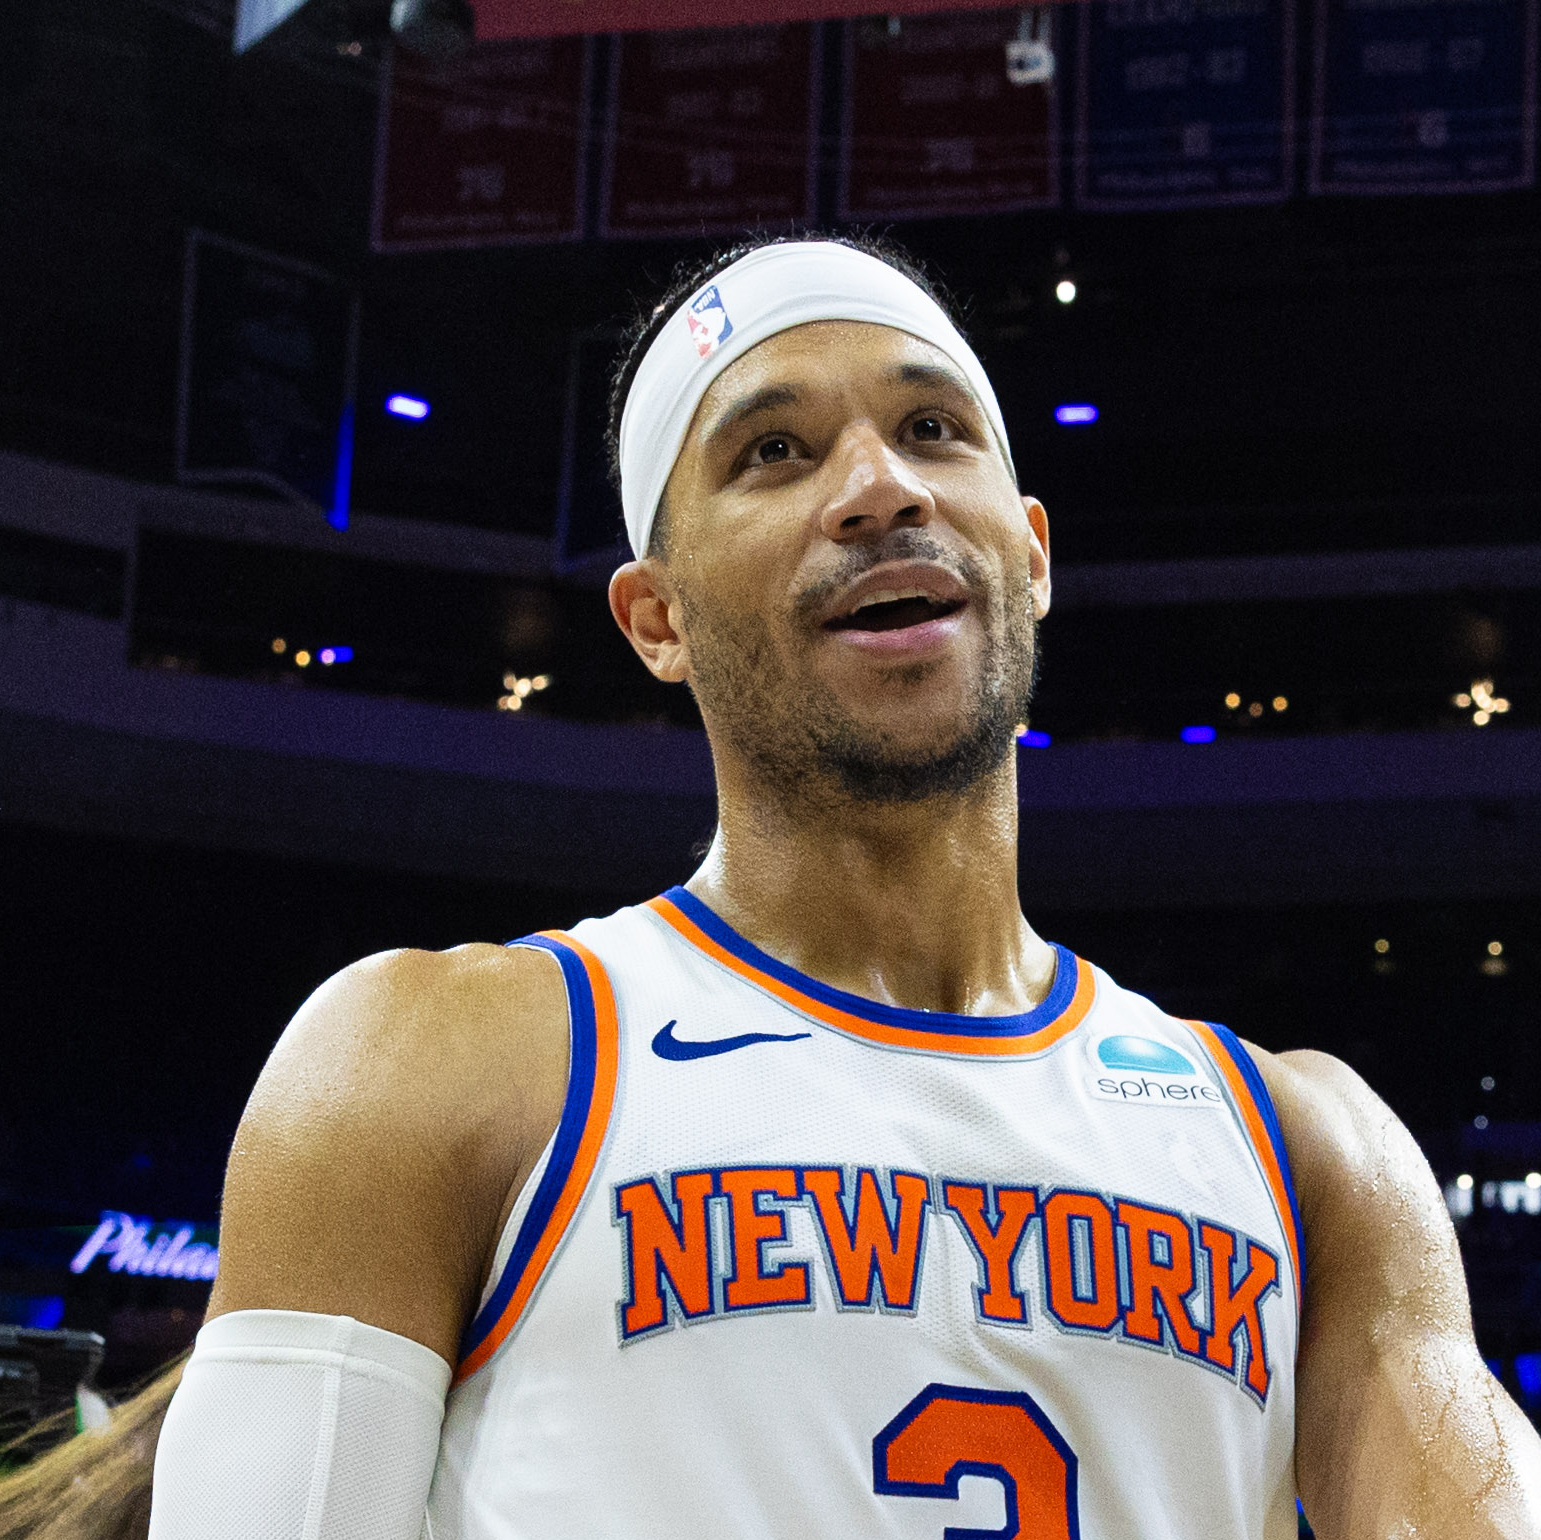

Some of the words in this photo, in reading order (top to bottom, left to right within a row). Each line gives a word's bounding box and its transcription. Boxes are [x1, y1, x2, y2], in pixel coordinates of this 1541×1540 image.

[1097, 1077, 1222, 1103] sphere
[615, 1164, 929, 1346] NEW
[936, 1180, 1281, 1410] YORK
